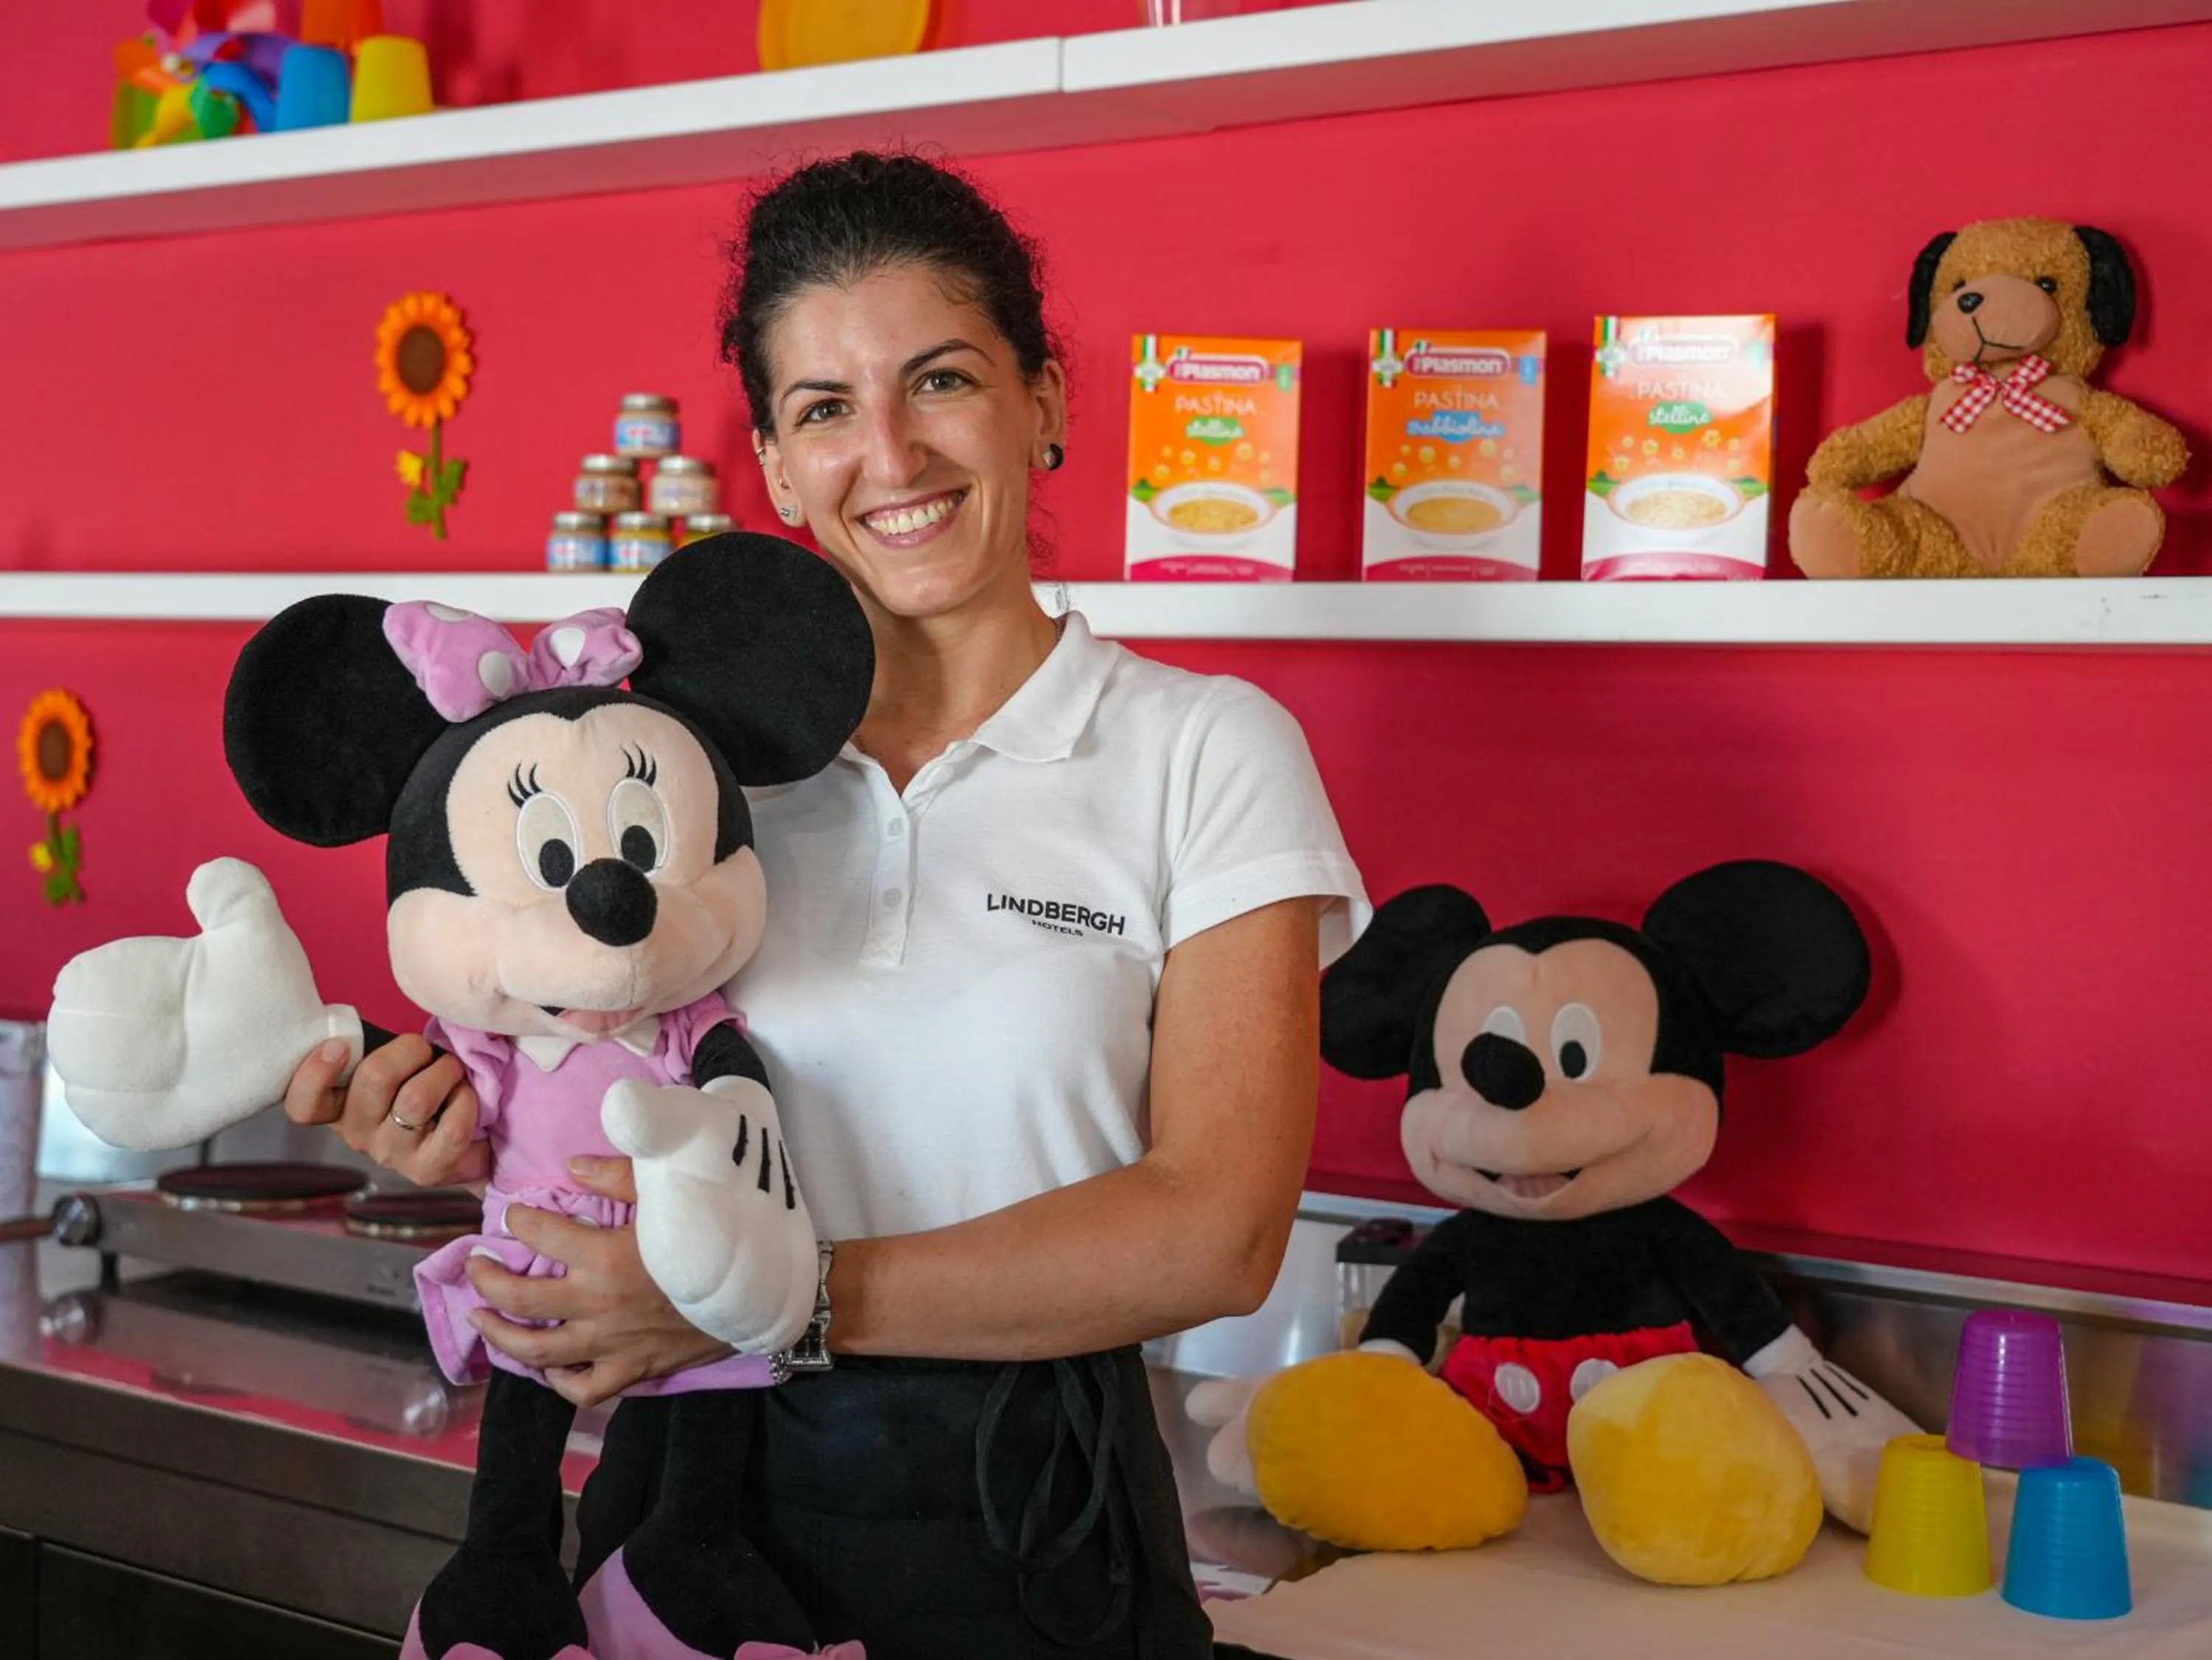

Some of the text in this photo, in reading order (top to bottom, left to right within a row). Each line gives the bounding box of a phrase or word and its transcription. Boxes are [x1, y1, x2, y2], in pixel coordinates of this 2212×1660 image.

[1175, 392, 1256, 415] PASTINA
[1413, 387, 1498, 409] PASTINA
[987, 893, 1125, 935] LINDBERGH
[1032, 920, 1083, 936] HOTELS
